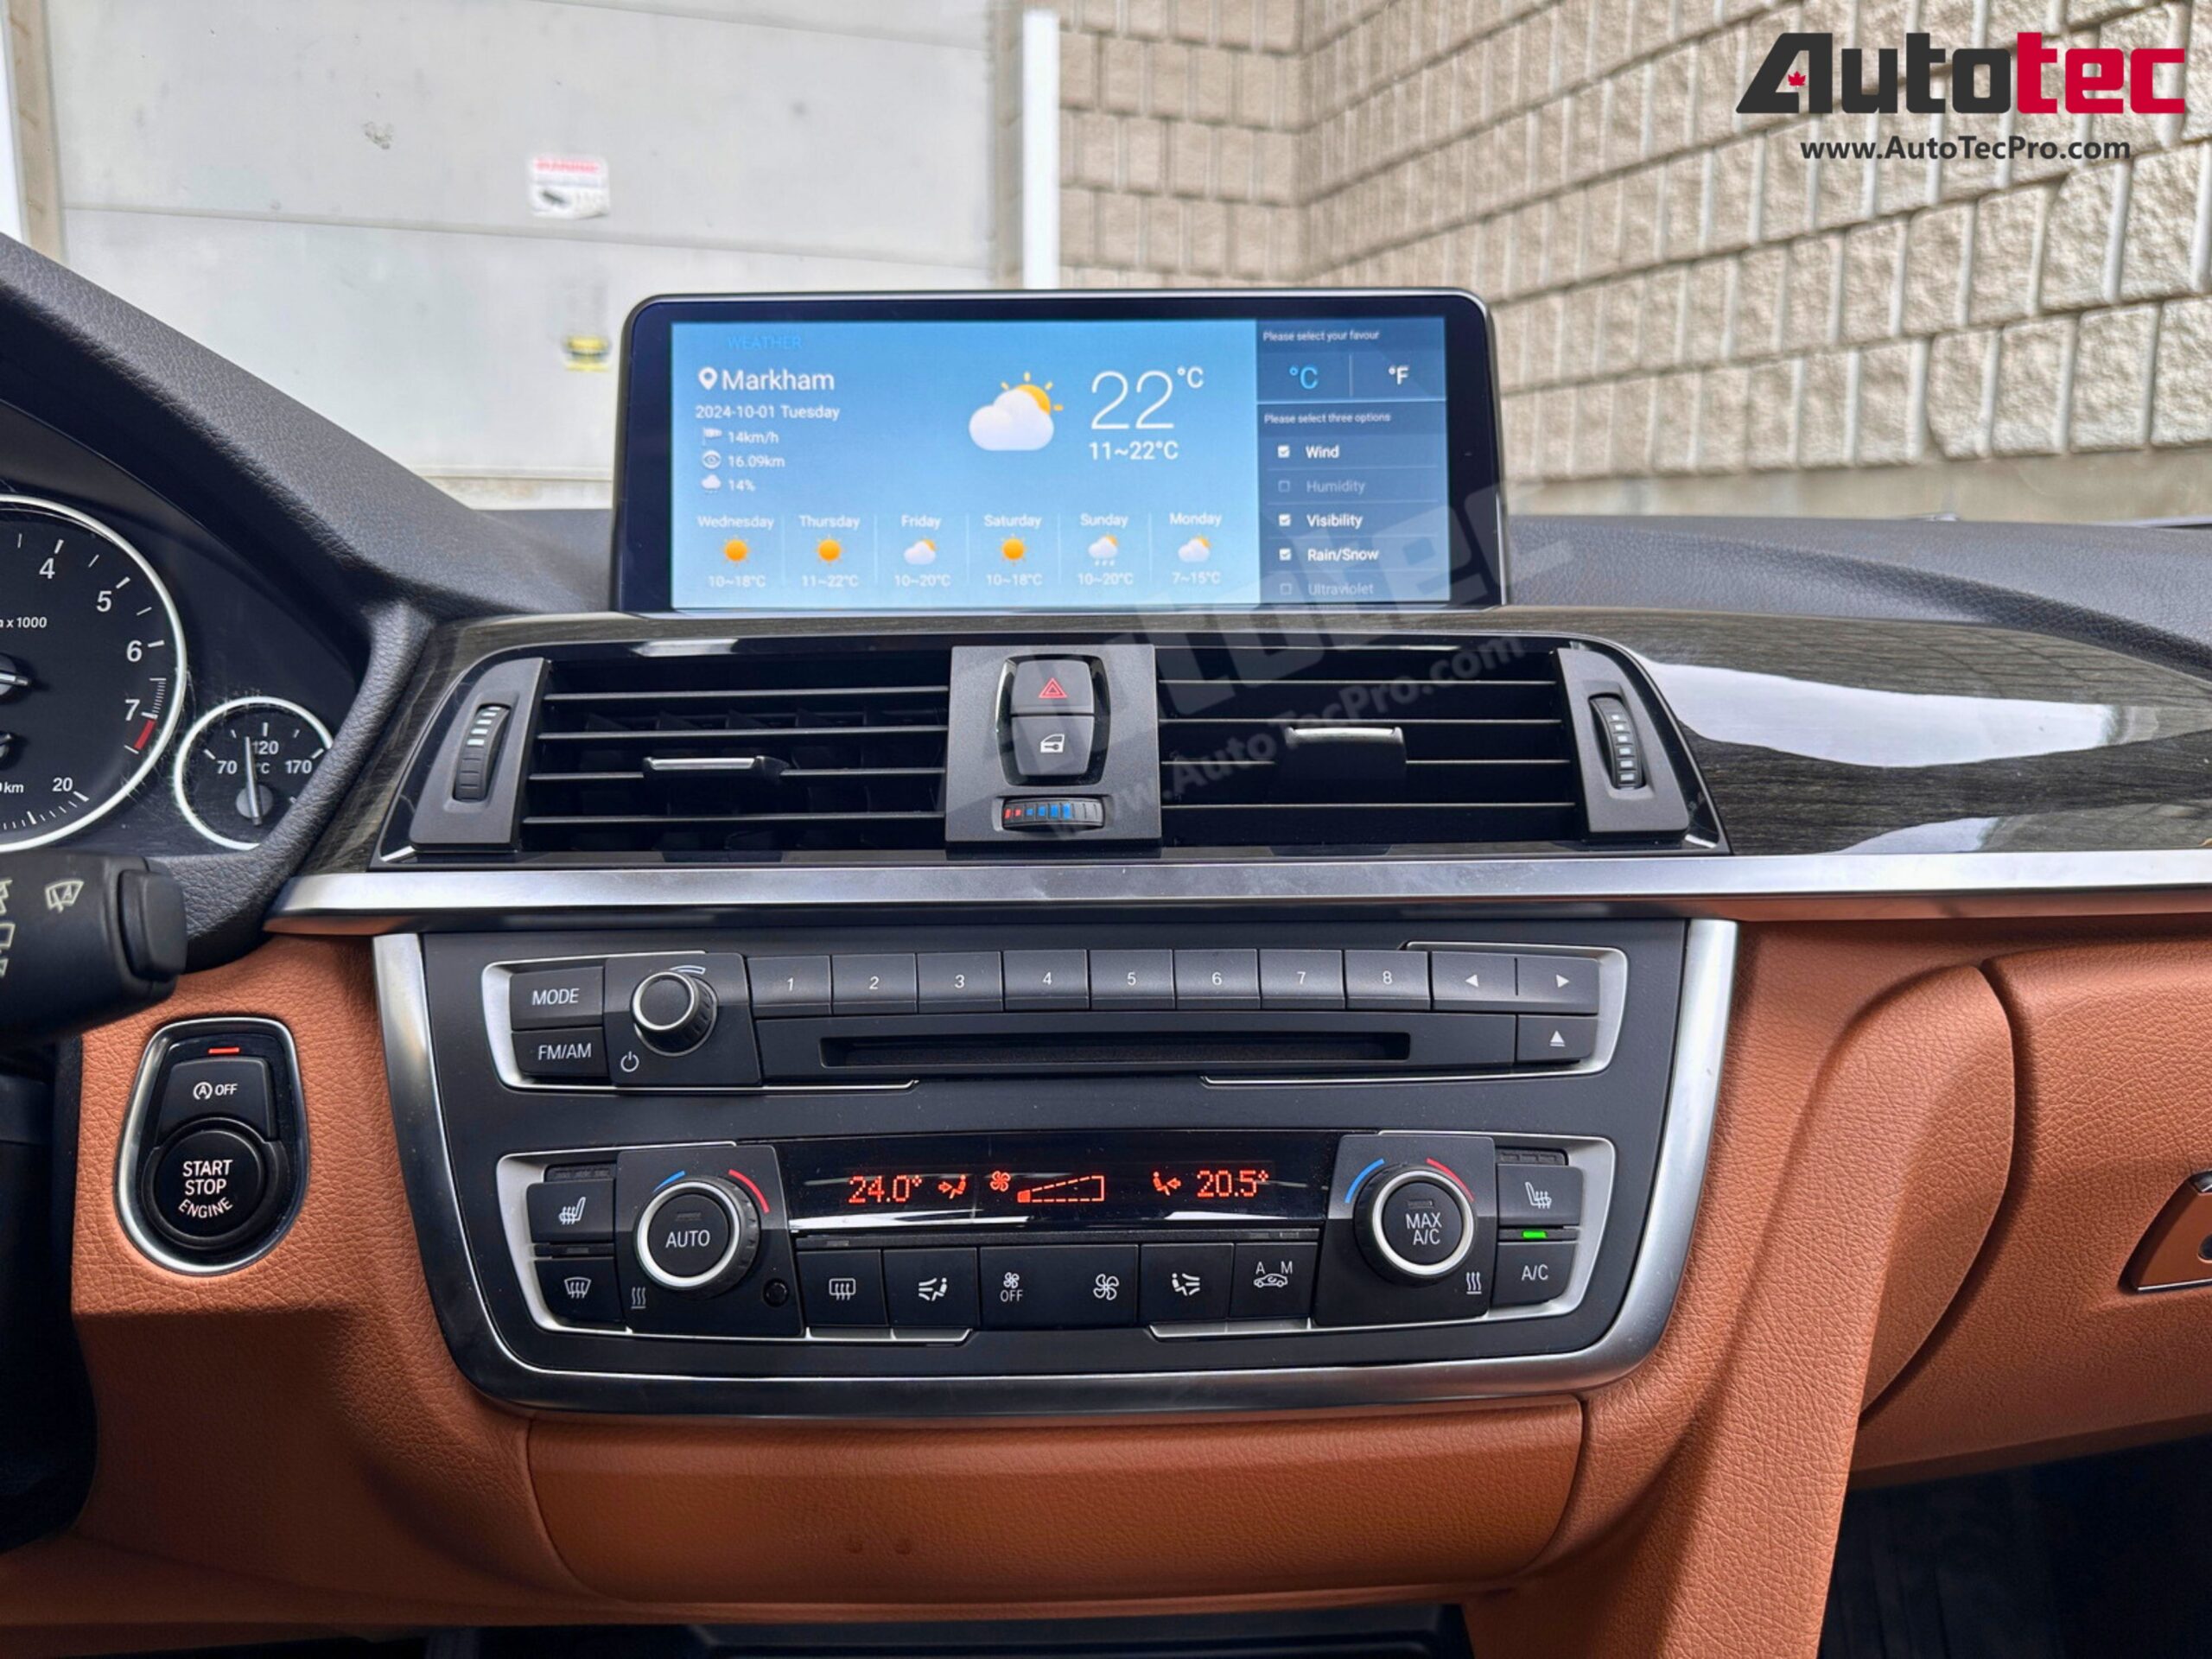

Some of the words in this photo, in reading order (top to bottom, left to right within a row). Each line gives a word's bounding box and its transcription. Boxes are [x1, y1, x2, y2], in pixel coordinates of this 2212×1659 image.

[725, 334, 804, 350] WEATHER
[1262, 330, 1295, 342] Please
[1296, 331, 1325, 341] select
[1326, 331, 1348, 343] your
[1349, 329, 1380, 340] favour
[721, 368, 835, 391] Markham
[1289, 365, 1319, 390] °C
[1388, 365, 1409, 385] °F
[695, 404, 775, 419] 2024-10-01
[779, 404, 841, 422] Tuesday
[1263, 413, 1295, 424] Please
[1297, 413, 1325, 423] select
[1327, 412, 1354, 423] three
[1354, 412, 1392, 424] options
[728, 430, 779, 444] 14km/h
[1089, 440, 1179, 461] 11~22°C
[1305, 444, 1340, 459] Wind
[728, 454, 785, 468] 16.09km
[728, 479, 756, 492] 14%
[1306, 479, 1366, 495] Humidity
[696, 514, 775, 531] Wednesday
[798, 514, 861, 531] Thursday
[900, 514, 942, 531] Friday
[983, 513, 1042, 530] Saturday
[1080, 512, 1129, 529] Sunday
[1169, 512, 1223, 528] Monday
[1306, 513, 1363, 530] Visibility
[1307, 547, 1380, 562] Rain/Snow
[39, 557, 55, 580] 4
[1307, 582, 1374, 595] Ultraviolet
[96, 590, 112, 613] 5
[16, 616, 48, 629] 1000
[126, 639, 143, 663] 6
[124, 698, 141, 721] 7
[252, 740, 279, 755] 120
[217, 760, 238, 775] 70
[284, 759, 313, 774] 170
[52, 777, 73, 792] 20
[787, 975, 794, 992] 1
[868, 976, 880, 990] 2
[954, 974, 965, 989] 3
[1042, 972, 1052, 985] 4
[1127, 971, 1137, 986] 5
[1211, 970, 1222, 985] 6
[1297, 970, 1306, 985] 7
[1382, 970, 1392, 985] 8
[531, 988, 580, 1006] MODE
[537, 1042, 592, 1060] FM/AM
[214, 1083, 238, 1096] OFF
[182, 1159, 233, 1178] START
[184, 1178, 227, 1196] STOP
[178, 1197, 233, 1219] ENGINE
[1405, 1211, 1443, 1228] MAX
[665, 1229, 710, 1249] AUTO
[1412, 1228, 1440, 1246] A/C
[1255, 1261, 1266, 1274] A
[1281, 1261, 1294, 1274] M
[1521, 1263, 1549, 1281] A/C
[1000, 1287, 1023, 1303] OFF
